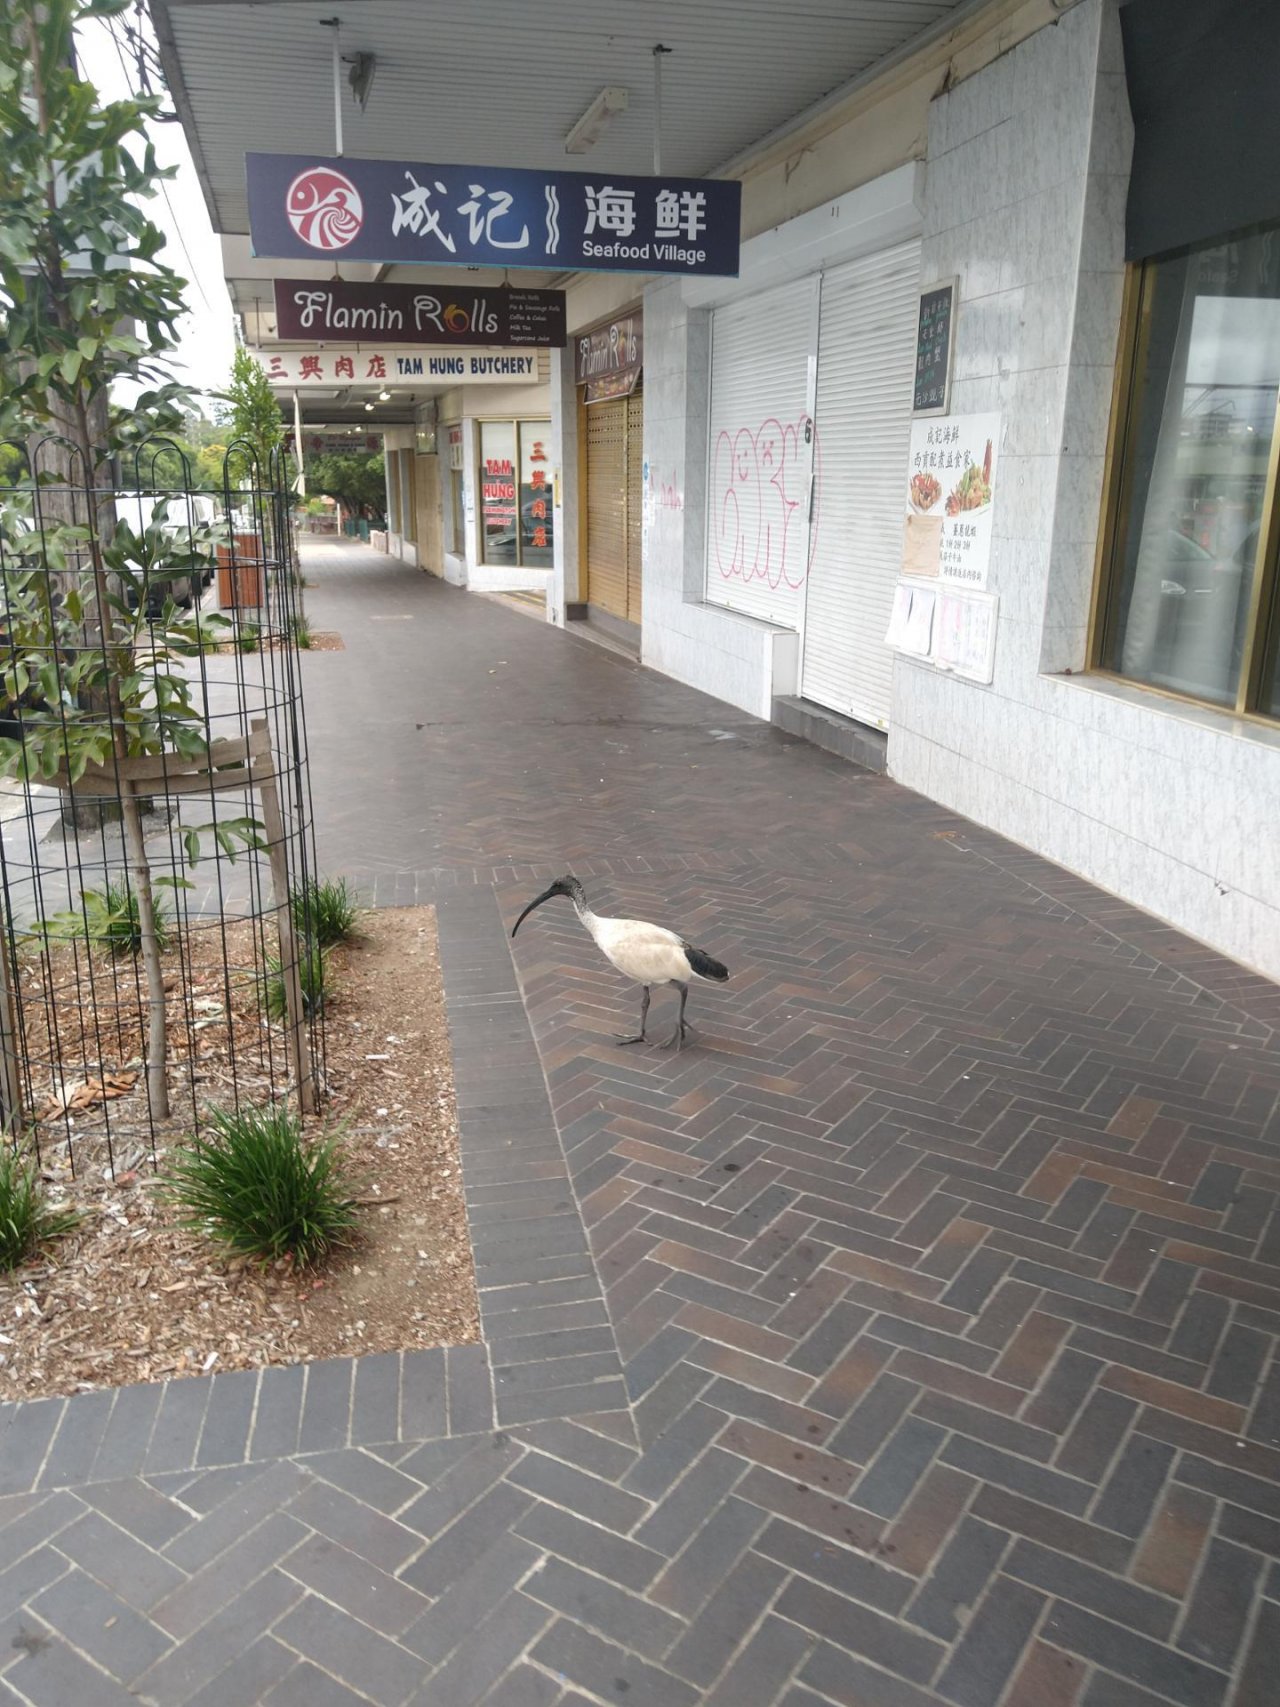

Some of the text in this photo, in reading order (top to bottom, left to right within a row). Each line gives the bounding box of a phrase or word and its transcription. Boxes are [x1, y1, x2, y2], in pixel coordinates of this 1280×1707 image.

[391, 171, 707, 253] 成记 海鲜
[582, 240, 706, 265] Seafood Village
[294, 291, 498, 333] Flamin Rolls
[266, 354, 387, 380] 三興肉店
[397, 356, 534, 375] TAM HUNG BUTCHERY
[486, 459, 512, 476] TAM
